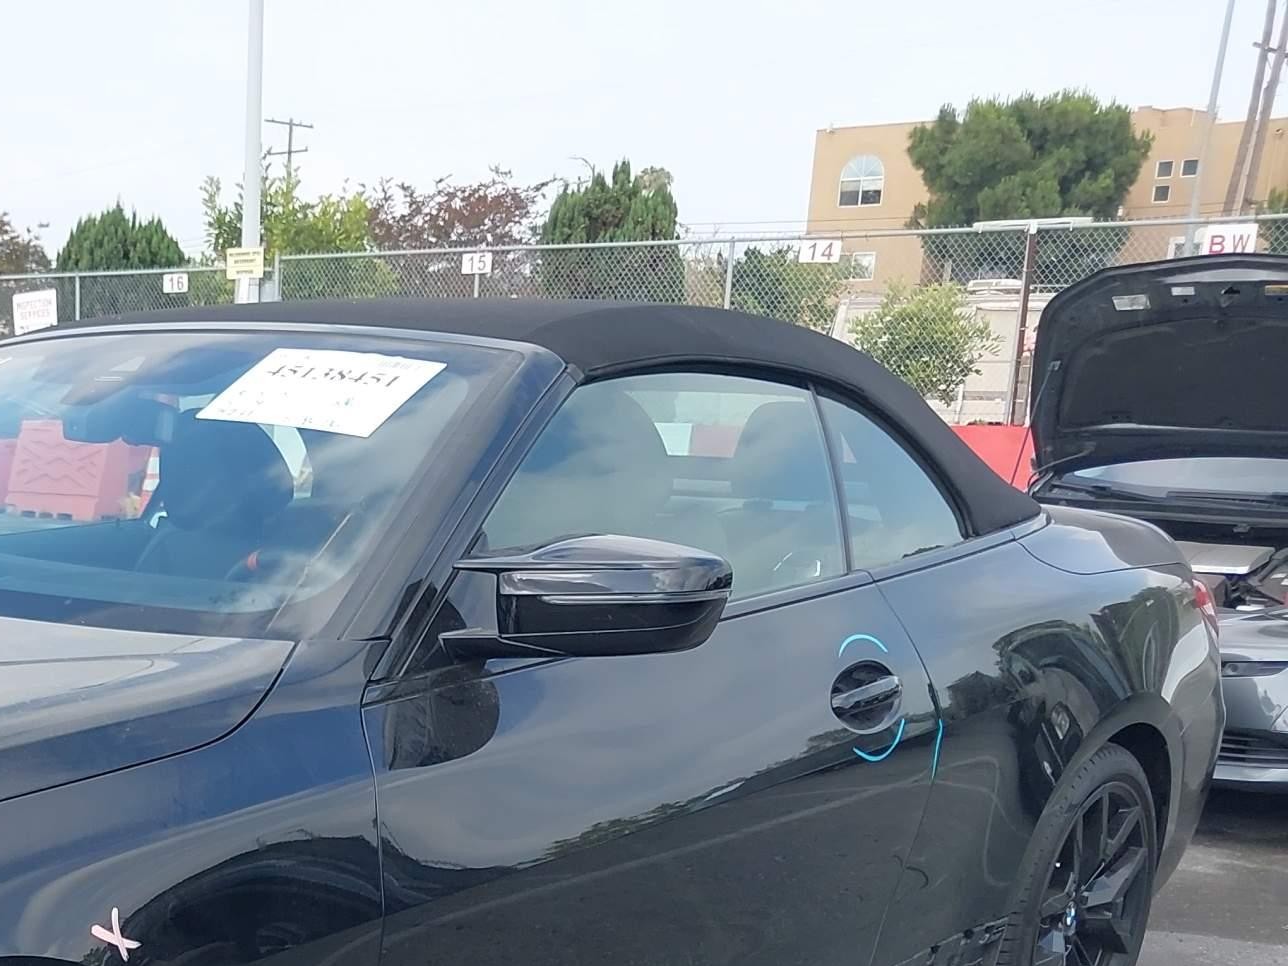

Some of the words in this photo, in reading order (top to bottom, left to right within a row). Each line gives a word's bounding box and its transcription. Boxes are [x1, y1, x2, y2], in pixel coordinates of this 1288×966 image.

[808, 242, 833, 261] 14
[468, 254, 487, 272] 15
[168, 275, 185, 291] 16
[267, 364, 400, 387] 45138451
